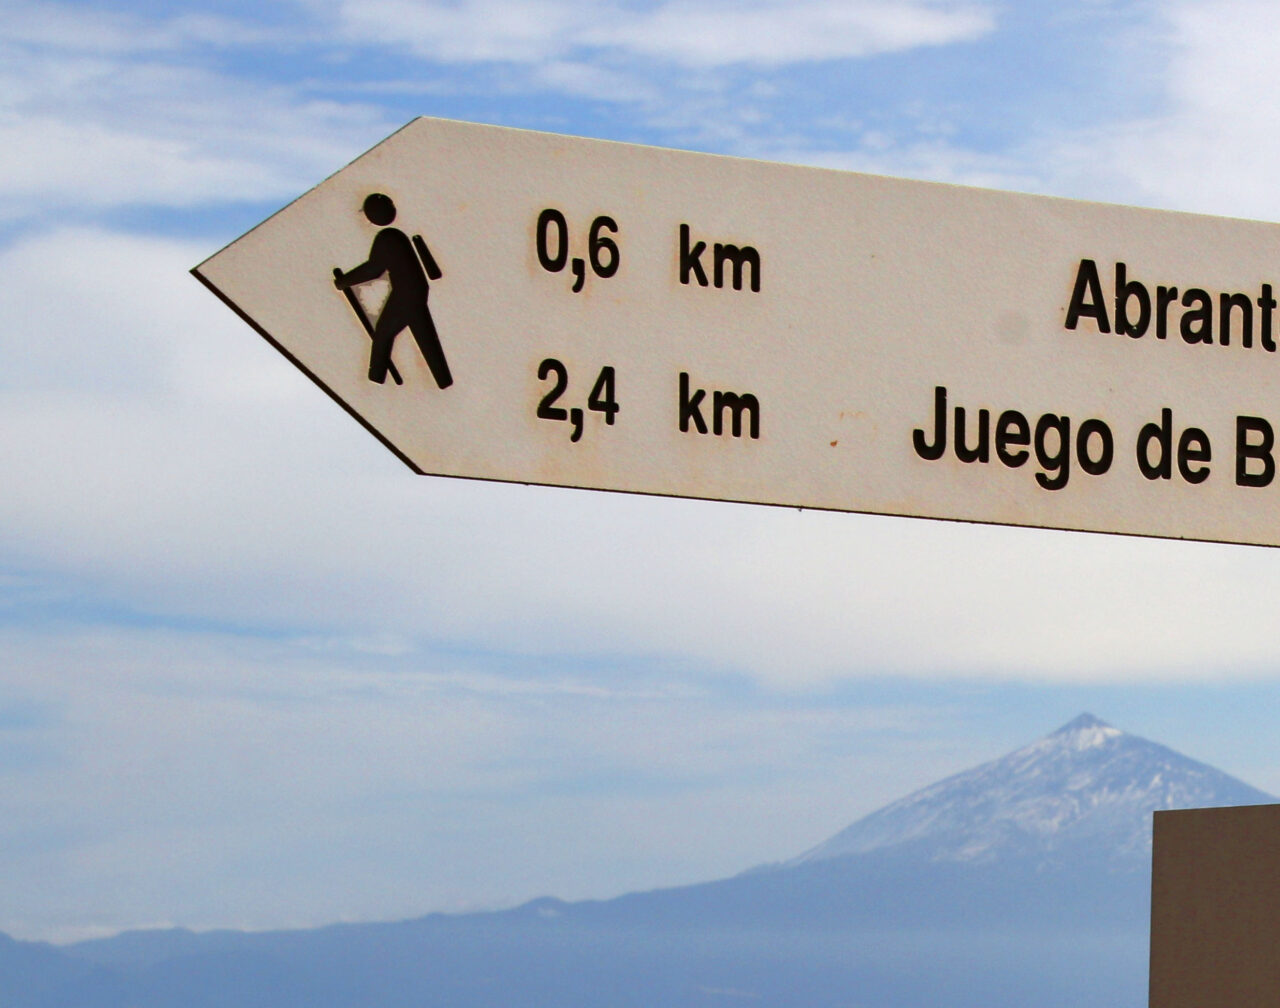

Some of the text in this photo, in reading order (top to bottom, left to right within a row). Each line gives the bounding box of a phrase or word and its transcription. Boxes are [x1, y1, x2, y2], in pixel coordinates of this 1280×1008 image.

[536, 208, 621, 294] 0,6
[679, 223, 761, 293] km
[536, 358, 621, 443] 2,4
[678, 371, 760, 440] km
[912, 385, 1114, 491] Juego
[1136, 407, 1212, 485] de
